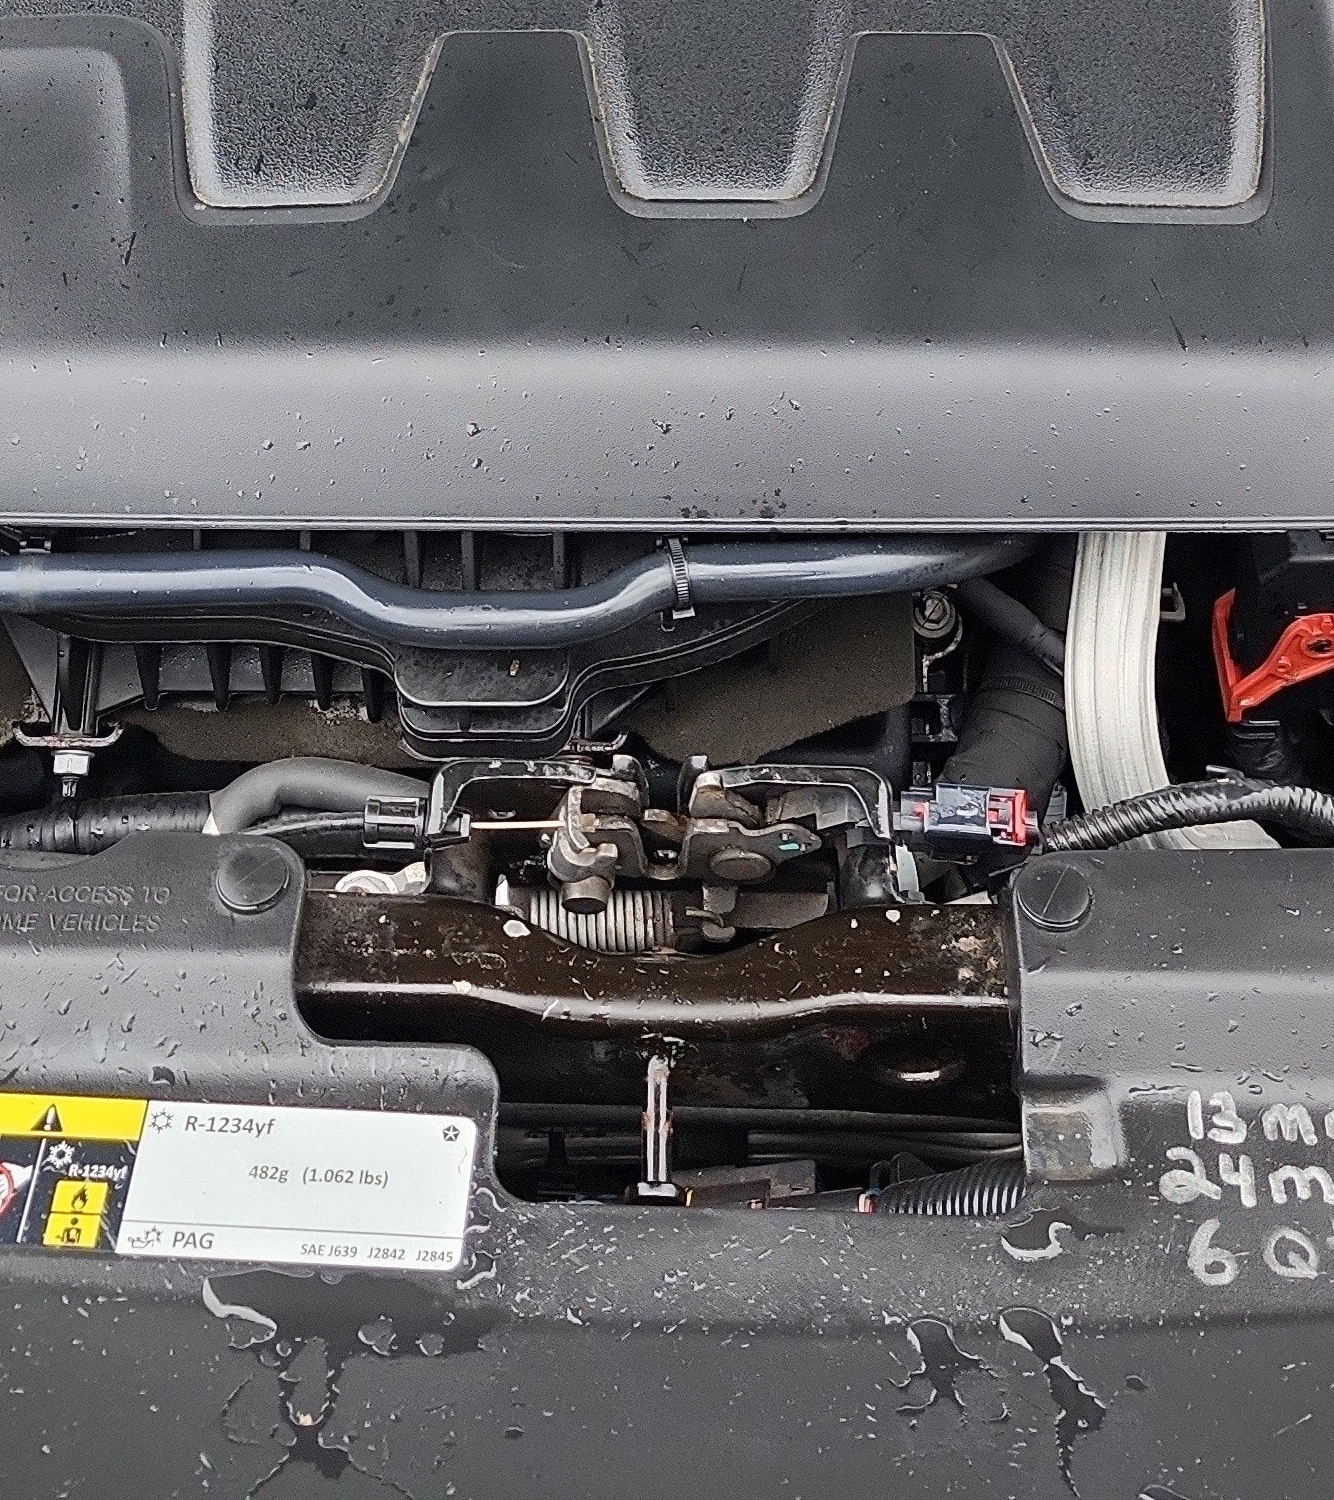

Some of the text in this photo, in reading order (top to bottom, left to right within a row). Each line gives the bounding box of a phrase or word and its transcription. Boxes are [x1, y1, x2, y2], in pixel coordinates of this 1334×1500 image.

[42, 885, 135, 904] ACCESS
[142, 886, 171, 905] TO
[48, 913, 164, 932] VEHICLES
[184, 1114, 276, 1139] R-1234yf
[67, 1163, 129, 1182] R-1234yf
[248, 1165, 389, 1189] 482g (1.062 lbs)
[172, 1230, 215, 1250] PAG
[300, 1243, 454, 1263] SAE J639 J2842 J2845
[1187, 1217, 1240, 1287] 6
